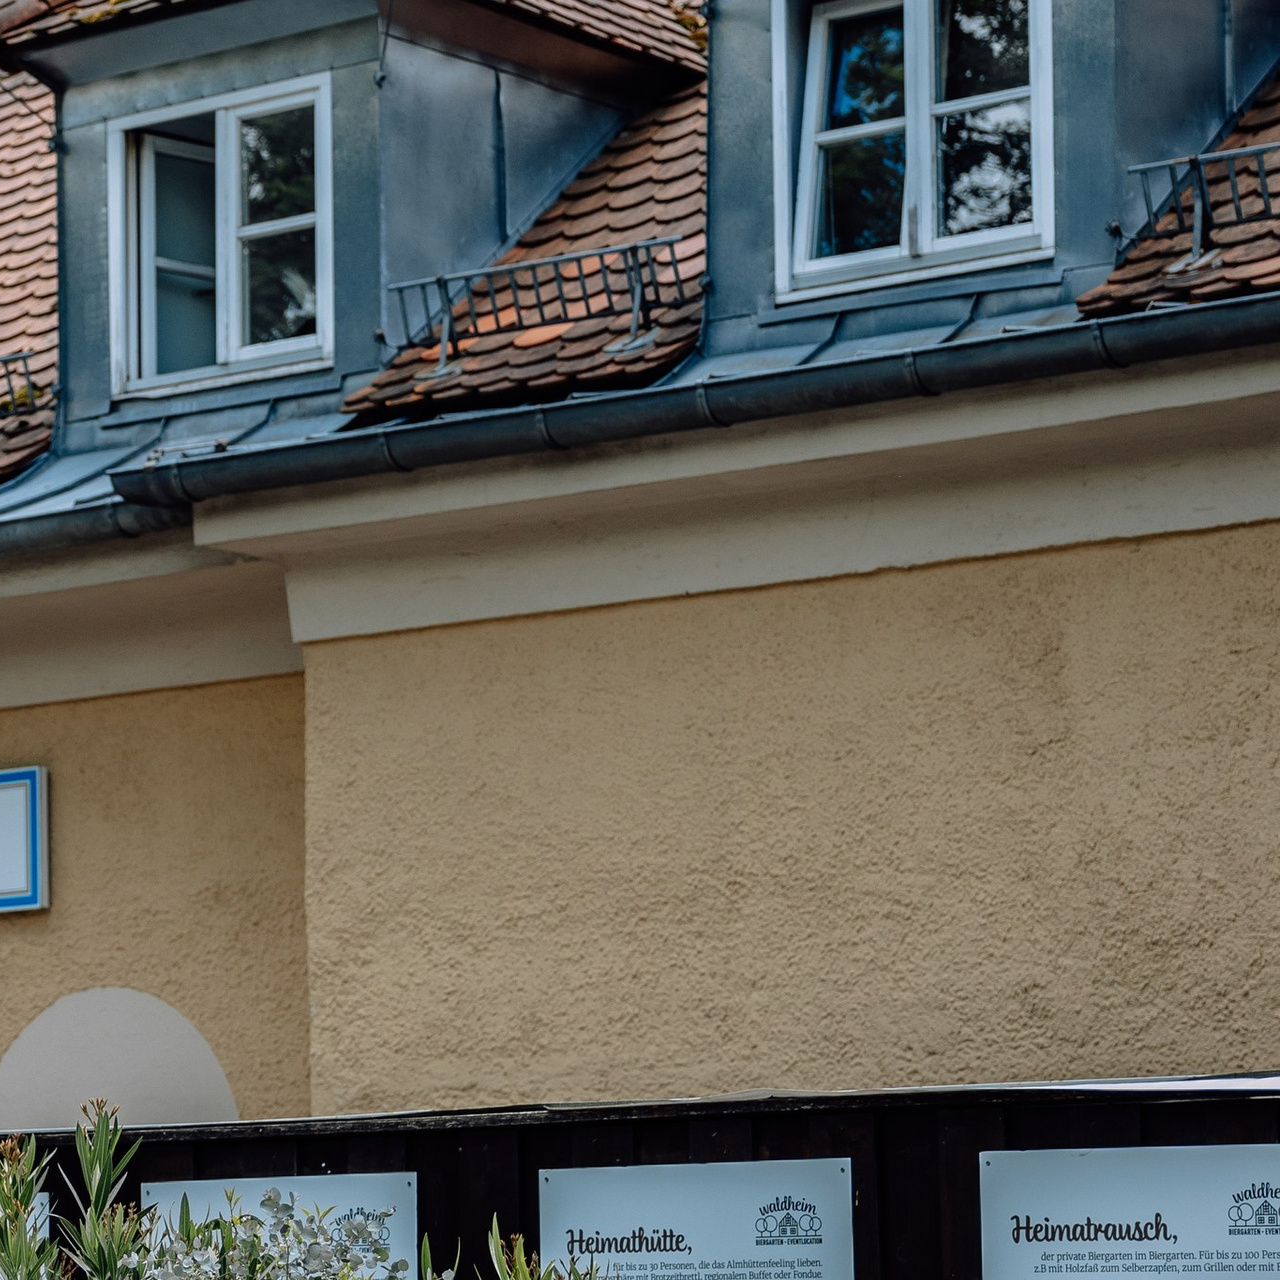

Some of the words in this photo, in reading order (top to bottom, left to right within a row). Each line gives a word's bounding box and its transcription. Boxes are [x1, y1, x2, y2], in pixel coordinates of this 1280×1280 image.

[759, 1195, 817, 1216] waldheim
[1011, 1212, 1178, 1244] Heimatrausch,
[1228, 1228, 1260, 1236] BIERGARTEN
[565, 1226, 693, 1256] Heimathütte,
[1041, 1251, 1055, 1261] der
[1056, 1251, 1086, 1262] private
[1088, 1251, 1133, 1263] Biergarten
[1134, 1251, 1147, 1260] im
[1149, 1250, 1197, 1262] Biergarten.
[1199, 1250, 1215, 1260] Für
[1216, 1250, 1230, 1259] bis
[1231, 1251, 1243, 1260] zu
[1244, 1251, 1260, 1260] 100
[613, 1261, 624, 1272] für
[625, 1261, 637, 1271] bis
[650, 1263, 658, 1272] 30
[660, 1261, 697, 1272] Personen,
[698, 1260, 710, 1270] die
[711, 1260, 725, 1269] das
[726, 1258, 796, 1270] Almhüttenfeeling
[797, 1258, 823, 1268] lieben.
[1034, 1263, 1047, 1273] z.B
[1048, 1263, 1063, 1273] mit
[1065, 1262, 1099, 1273] Holzfaß
[1100, 1264, 1120, 1273] zum
[1121, 1262, 1180, 1274] Selberzapfen,
[1182, 1264, 1202, 1272] zum
[1203, 1262, 1235, 1272] Grillen
[1236, 1262, 1257, 1272] oder
[1258, 1262, 1275, 1272] mit
[748, 1270, 772, 1280] Buffet
[773, 1270, 791, 1279] oder
[793, 1269, 823, 1279] Fondue.
